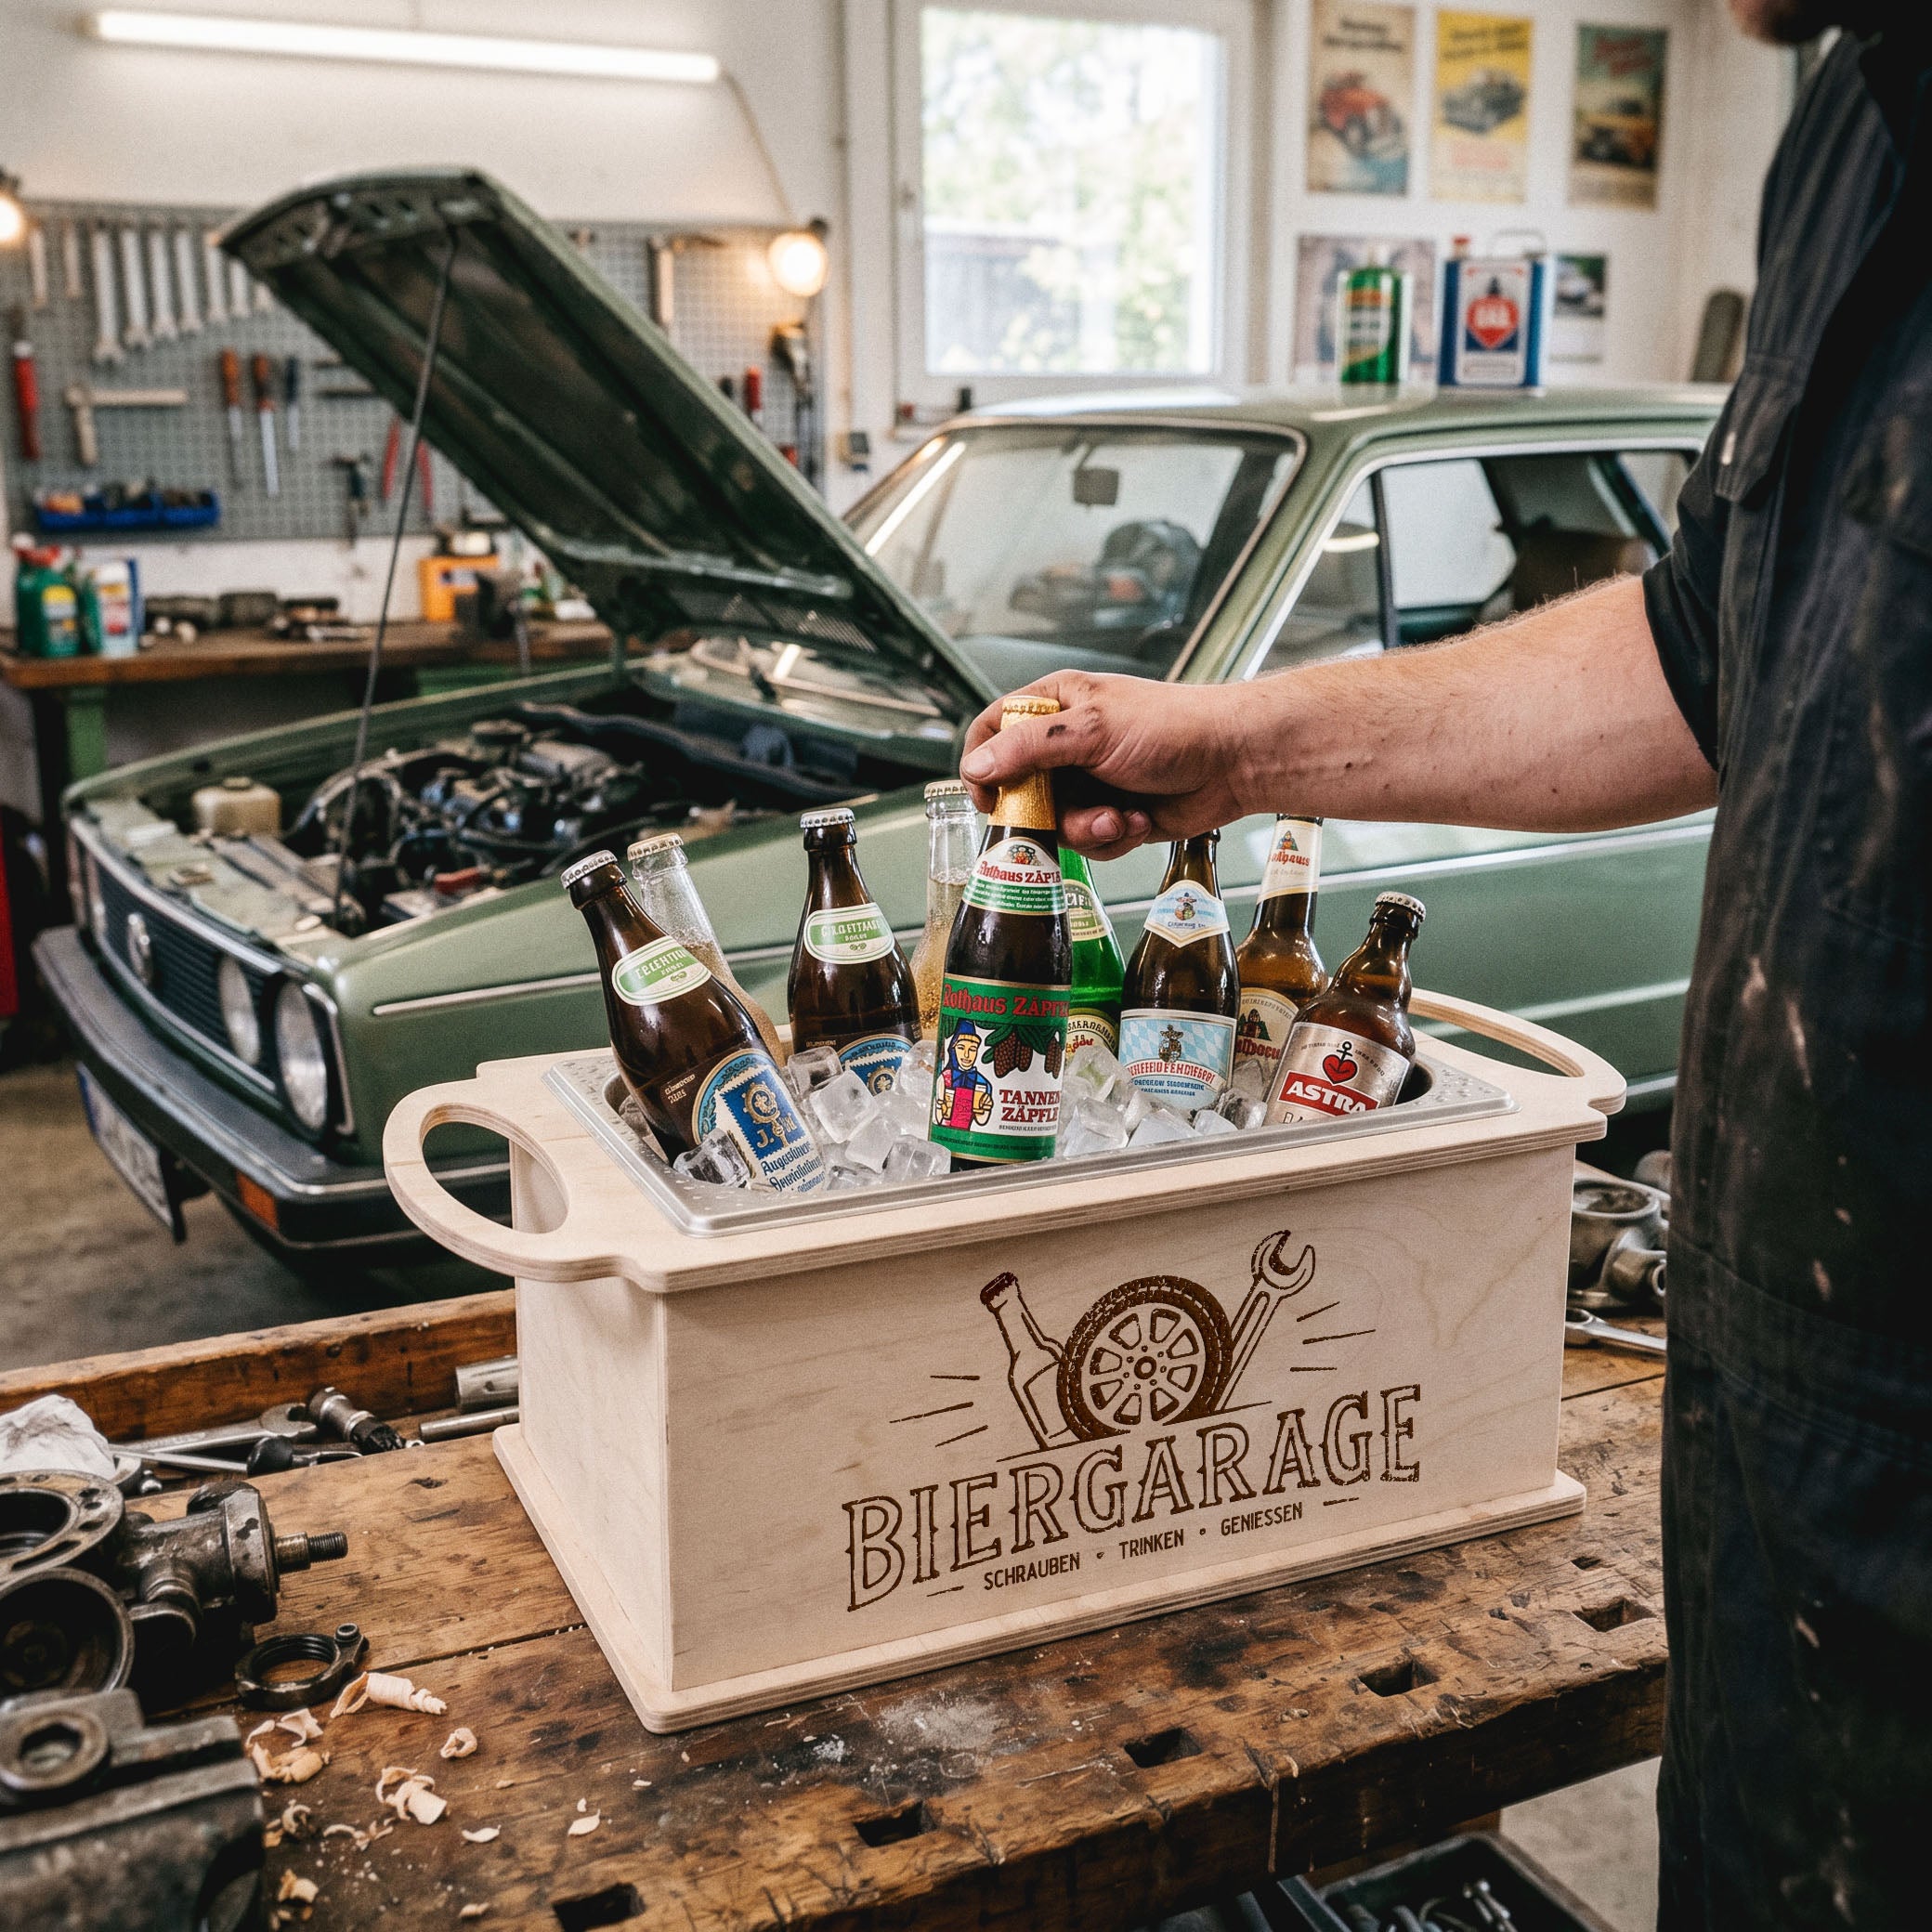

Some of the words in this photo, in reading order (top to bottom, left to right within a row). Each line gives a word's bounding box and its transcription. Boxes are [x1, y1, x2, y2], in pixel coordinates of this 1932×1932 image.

[943, 984, 1007, 1015] Rothaus
[1286, 1080, 1366, 1115] ASTRA
[842, 1384, 1421, 1612] BIERGARAGE
[983, 1551, 1081, 1591] SCHRAUBEN
[1118, 1528, 1185, 1560] TRINKEN
[1220, 1501, 1303, 1537] GENIESSEN
